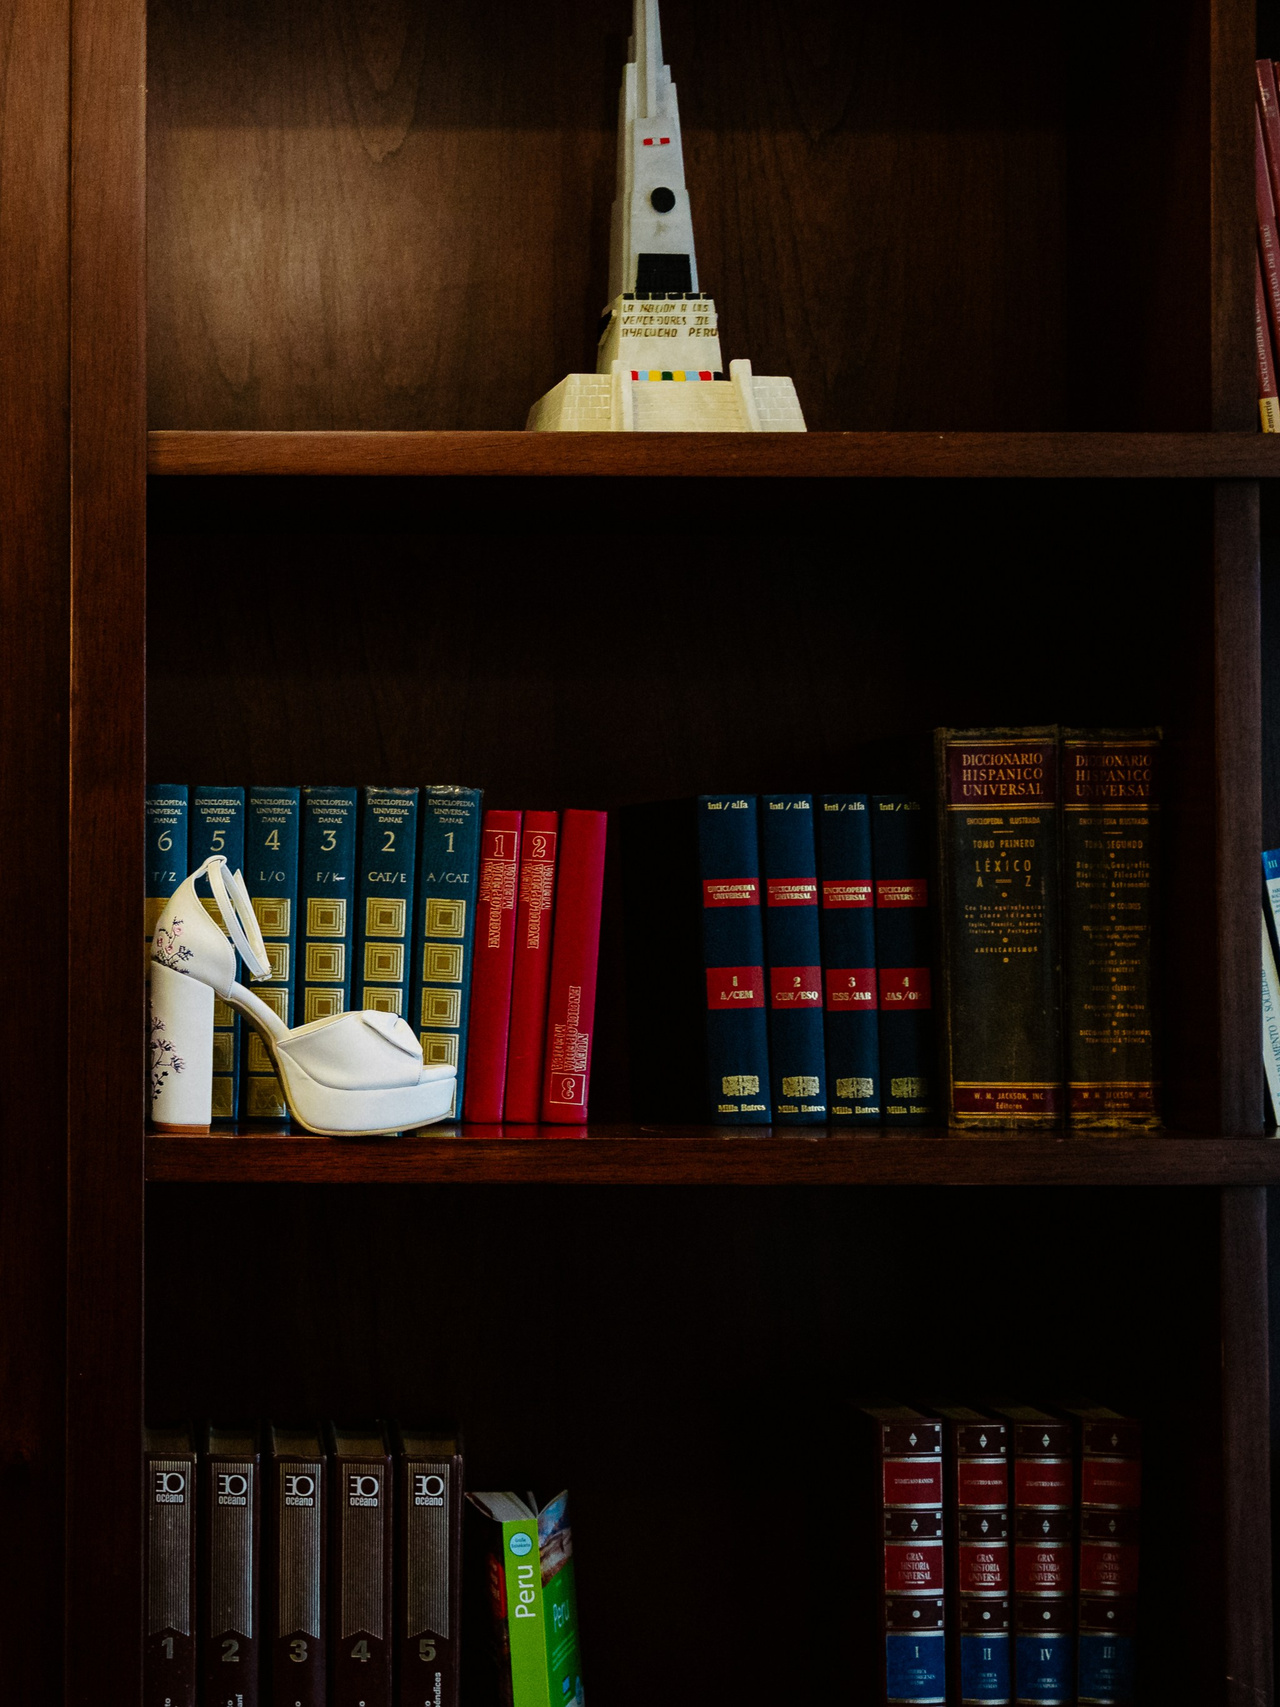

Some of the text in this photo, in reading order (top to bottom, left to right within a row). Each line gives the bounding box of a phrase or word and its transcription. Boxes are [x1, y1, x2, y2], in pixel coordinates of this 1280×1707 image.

[623, 304, 634, 312] LA
[695, 316, 710, 325] DE
[622, 327, 718, 338] AYACUCHO PERU
[962, 753, 1043, 767] DICCIONARIO
[962, 768, 1044, 782] HISPANICO
[962, 783, 1044, 797] UNIVERSAL
[731, 800, 749, 810] alfa
[157, 830, 173, 851] 6
[210, 830, 226, 852] 5
[265, 829, 281, 851] 4
[320, 830, 337, 851] 3
[381, 831, 396, 852] 2
[444, 831, 455, 853] 1
[494, 834, 505, 857] 1
[532, 836, 547, 858] 2
[973, 839, 995, 849] TOMO
[975, 858, 1032, 873] LÉXICO
[707, 884, 755, 892] ENCICLOPEDIA
[976, 875, 1032, 887] A Z
[713, 892, 750, 900] UNIVERSAL
[488, 862, 505, 948] ENCICLOPEDIA
[527, 863, 544, 949] ENCICLOPEDIA
[731, 976, 738, 987] 1
[793, 976, 801, 987] 2
[848, 976, 856, 987] 3
[902, 976, 909, 987] 4
[561, 1077, 575, 1100] 3
[741, 1103, 766, 1112] Batres
[977, 1554, 994, 1562] GRAN
[515, 1564, 536, 1618] Peru
[161, 1637, 174, 1659] 1
[221, 1639, 240, 1662] 2
[289, 1640, 308, 1662] 3
[350, 1639, 371, 1662] 4
[419, 1639, 437, 1662] 5
[915, 1646, 919, 1658] I
[983, 1648, 992, 1660] II
[1040, 1648, 1053, 1661] IV
